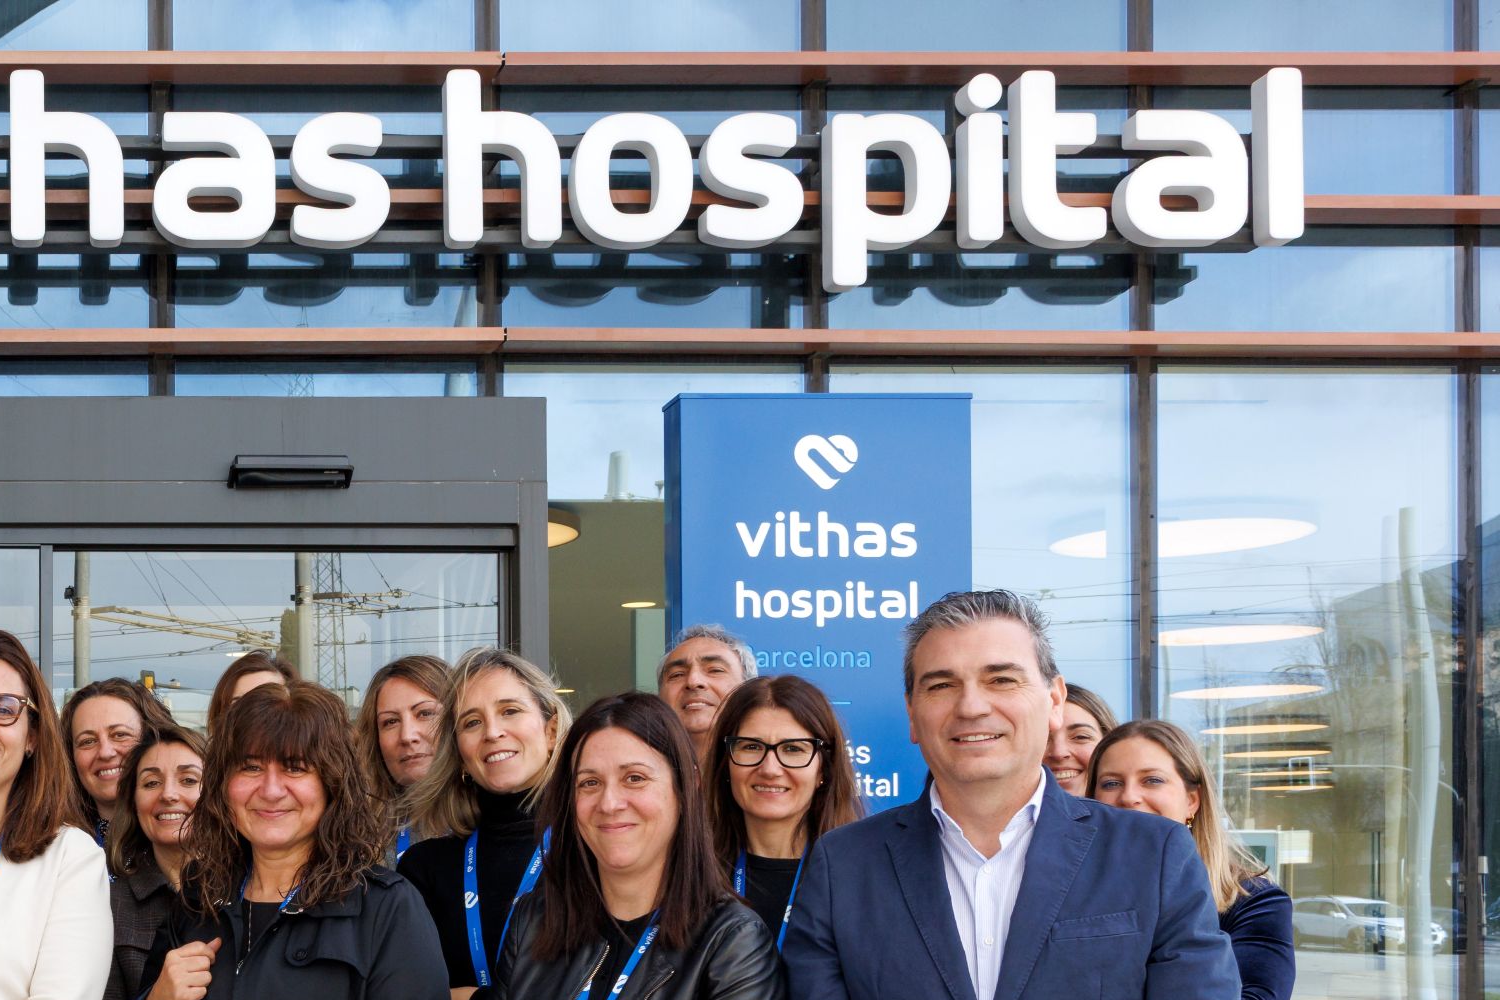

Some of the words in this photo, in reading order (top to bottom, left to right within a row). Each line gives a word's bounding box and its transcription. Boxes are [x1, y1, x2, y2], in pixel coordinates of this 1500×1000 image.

[442, 67, 1305, 294] hospital
[735, 511, 918, 558] vithas
[735, 580, 919, 628] hospital
[749, 645, 872, 669] arcelona
[855, 772, 899, 797] ital
